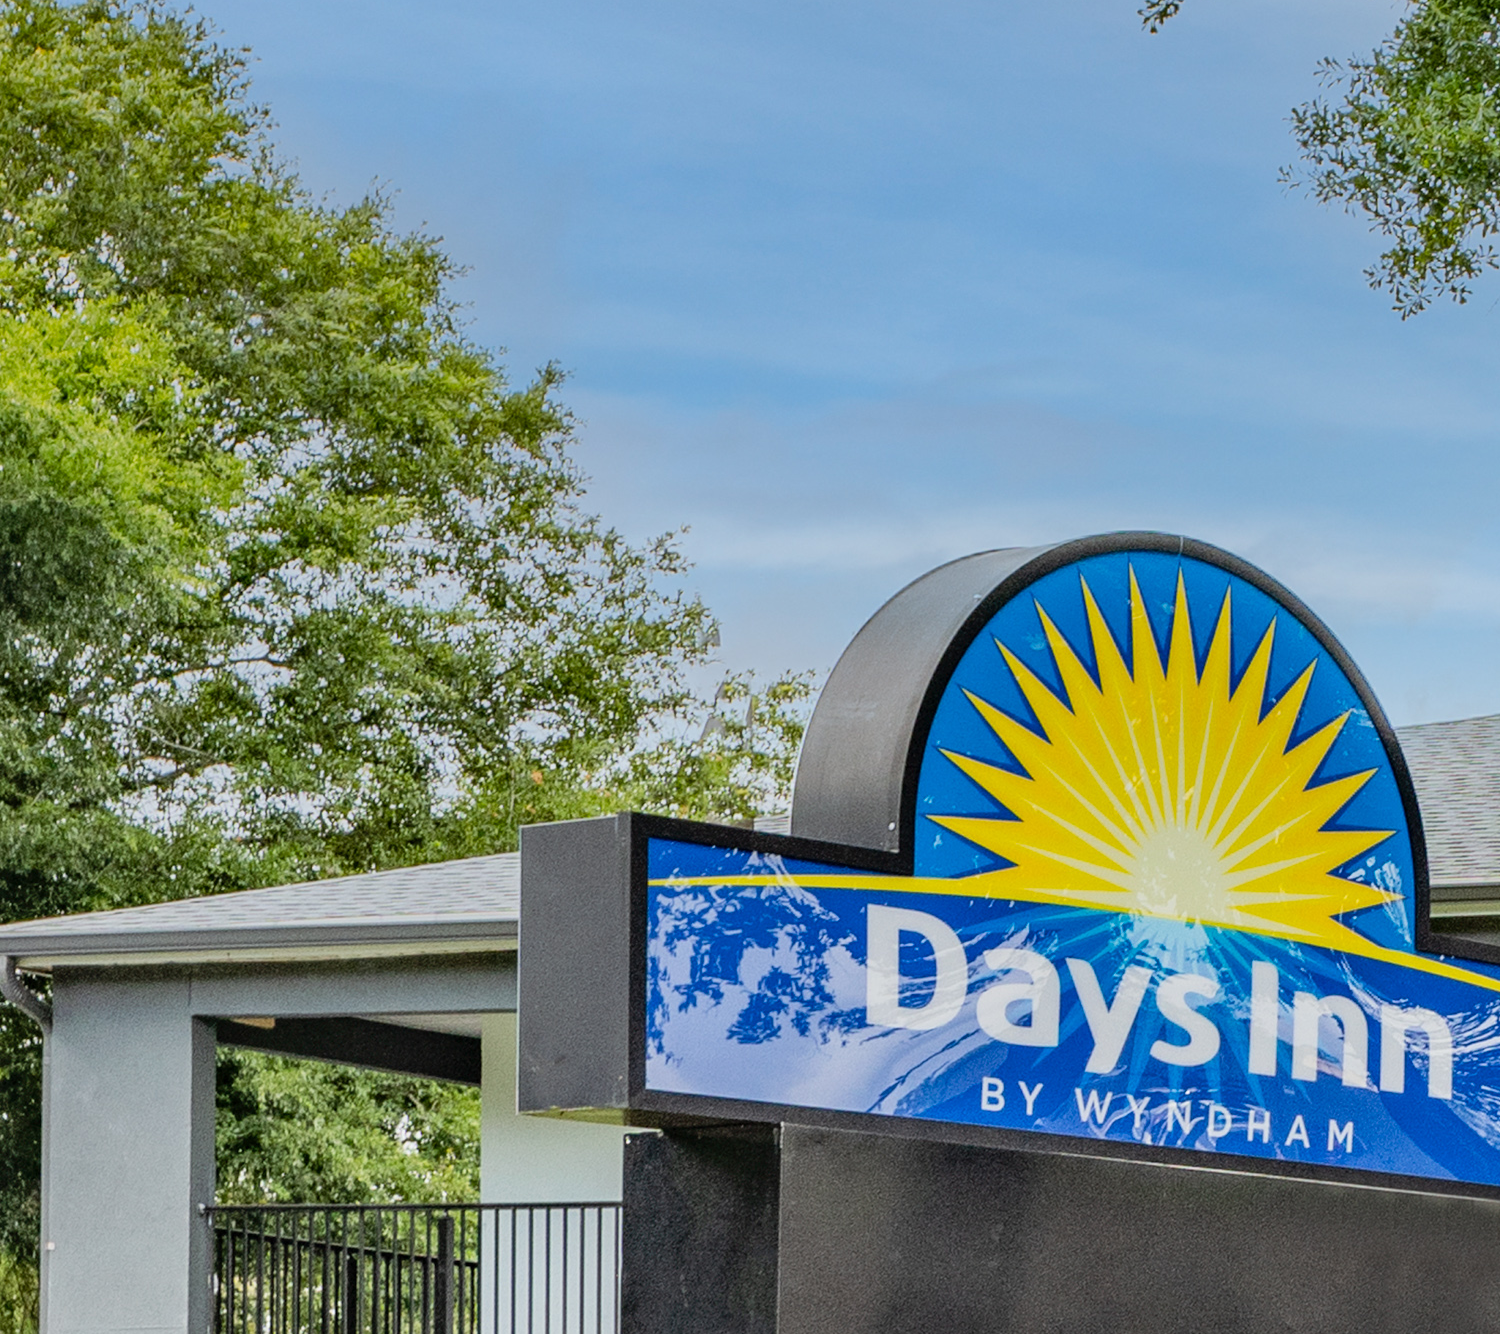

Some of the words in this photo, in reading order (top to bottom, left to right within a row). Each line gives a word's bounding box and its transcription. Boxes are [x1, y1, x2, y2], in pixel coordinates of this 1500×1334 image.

[866, 903, 1221, 1074] Days
[1248, 960, 1453, 1100] Inn
[980, 1076, 1044, 1116] BY
[1074, 1087, 1354, 1154] WYNDHAM
